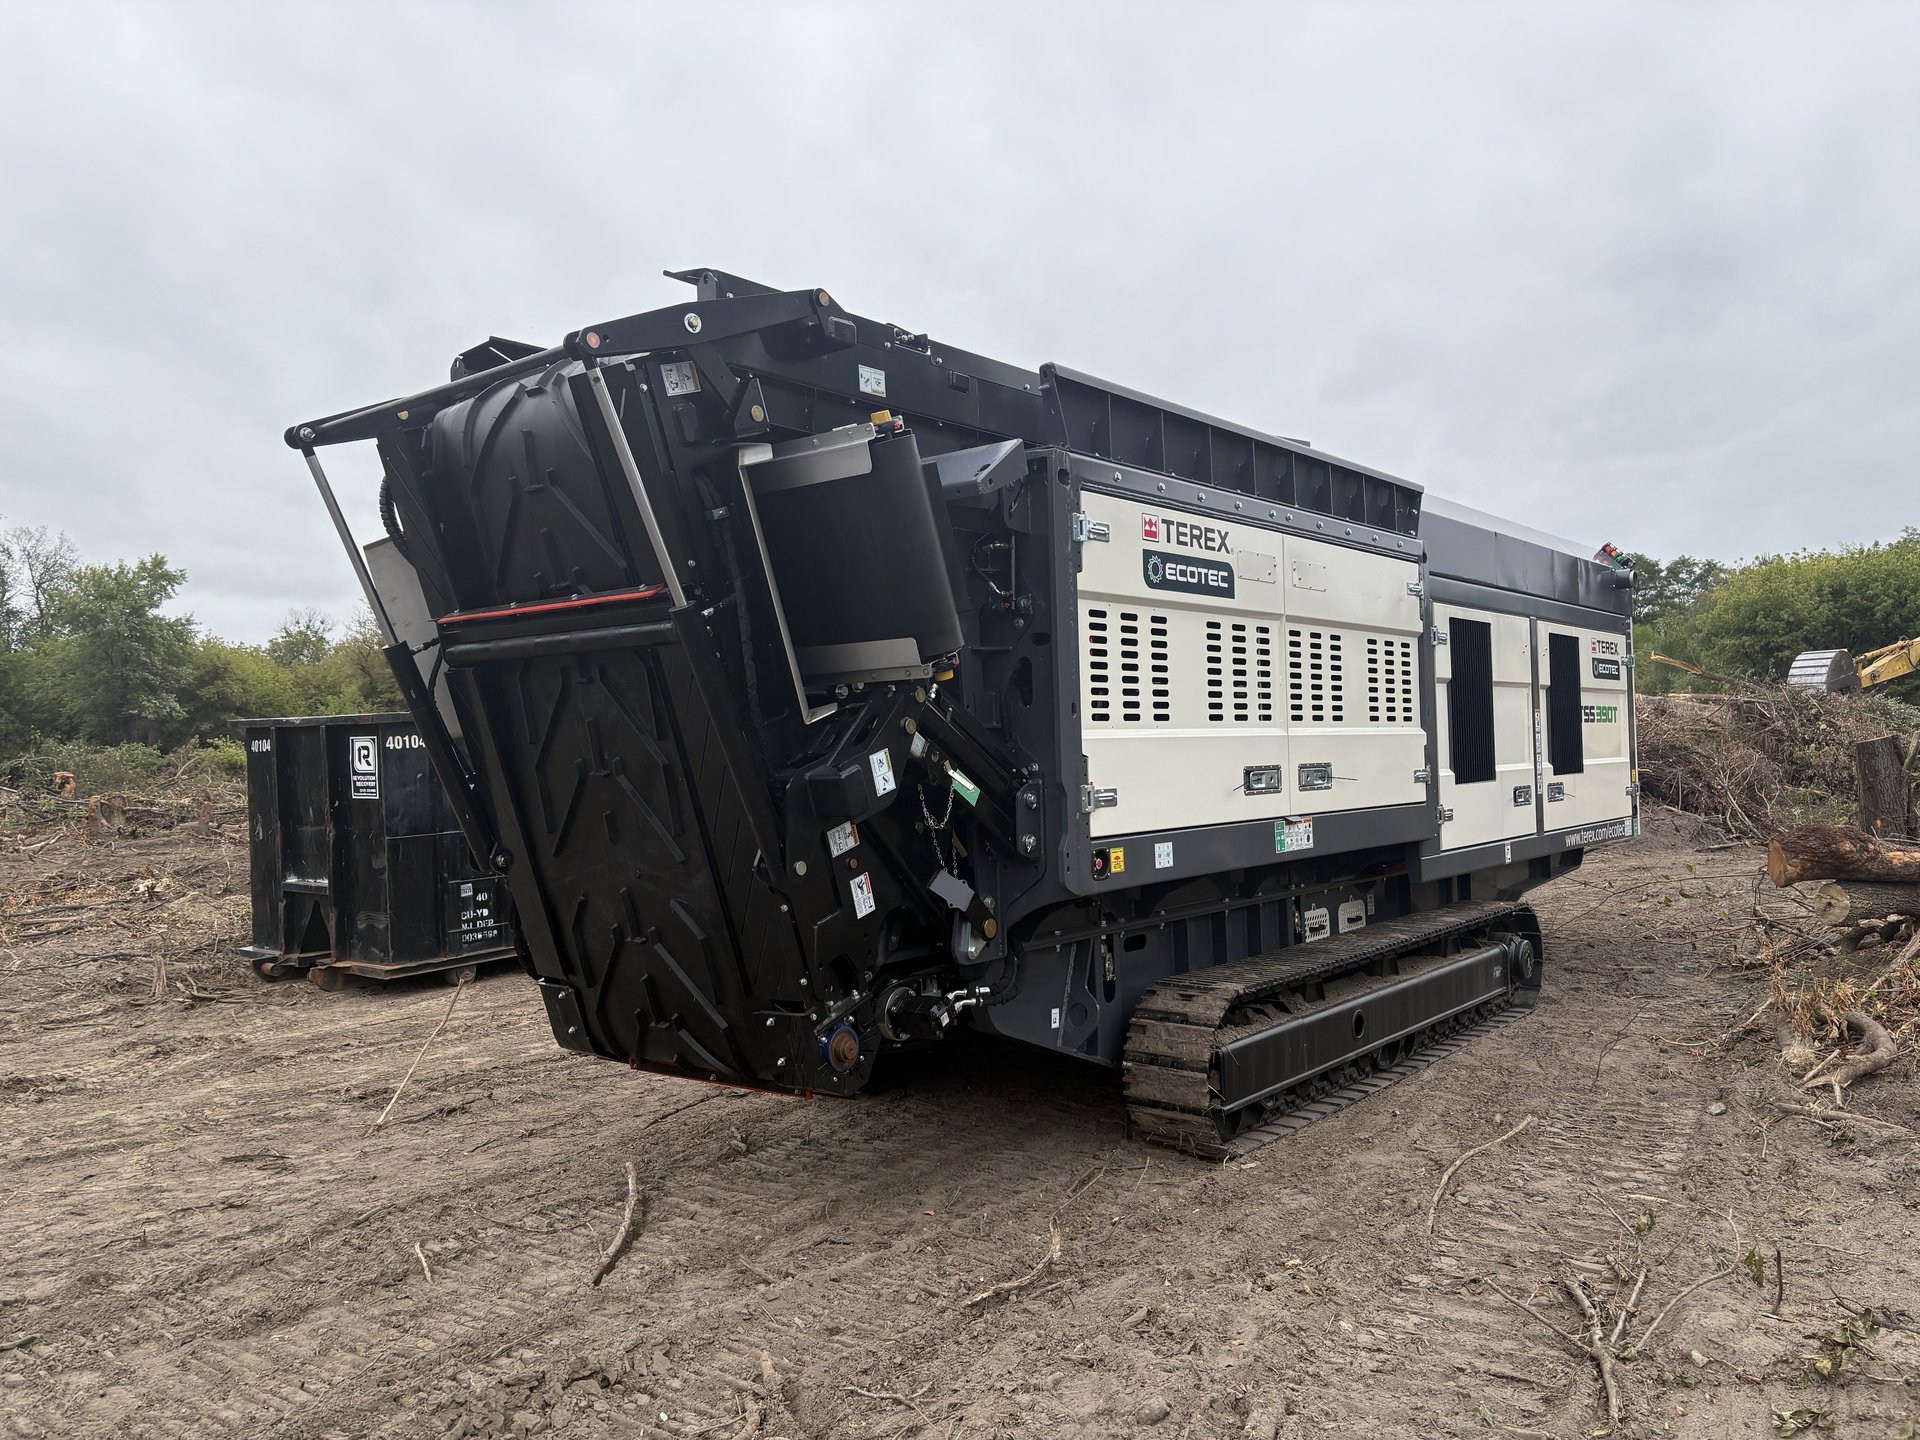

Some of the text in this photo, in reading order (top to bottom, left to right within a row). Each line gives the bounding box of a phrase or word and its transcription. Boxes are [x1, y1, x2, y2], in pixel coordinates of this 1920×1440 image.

[1161, 518, 1231, 554] TEREX
[1165, 562, 1229, 588] ECOTEC
[1597, 640, 1619, 656] TEREX
[1598, 663, 1619, 675] ECOTEC
[1581, 705, 1618, 723] SS390T
[251, 739, 271, 752] 40104
[1564, 823, 1625, 848] www.terex.com/ecotec
[476, 892, 488, 902] 40
[461, 908, 489, 920] CU-YD
